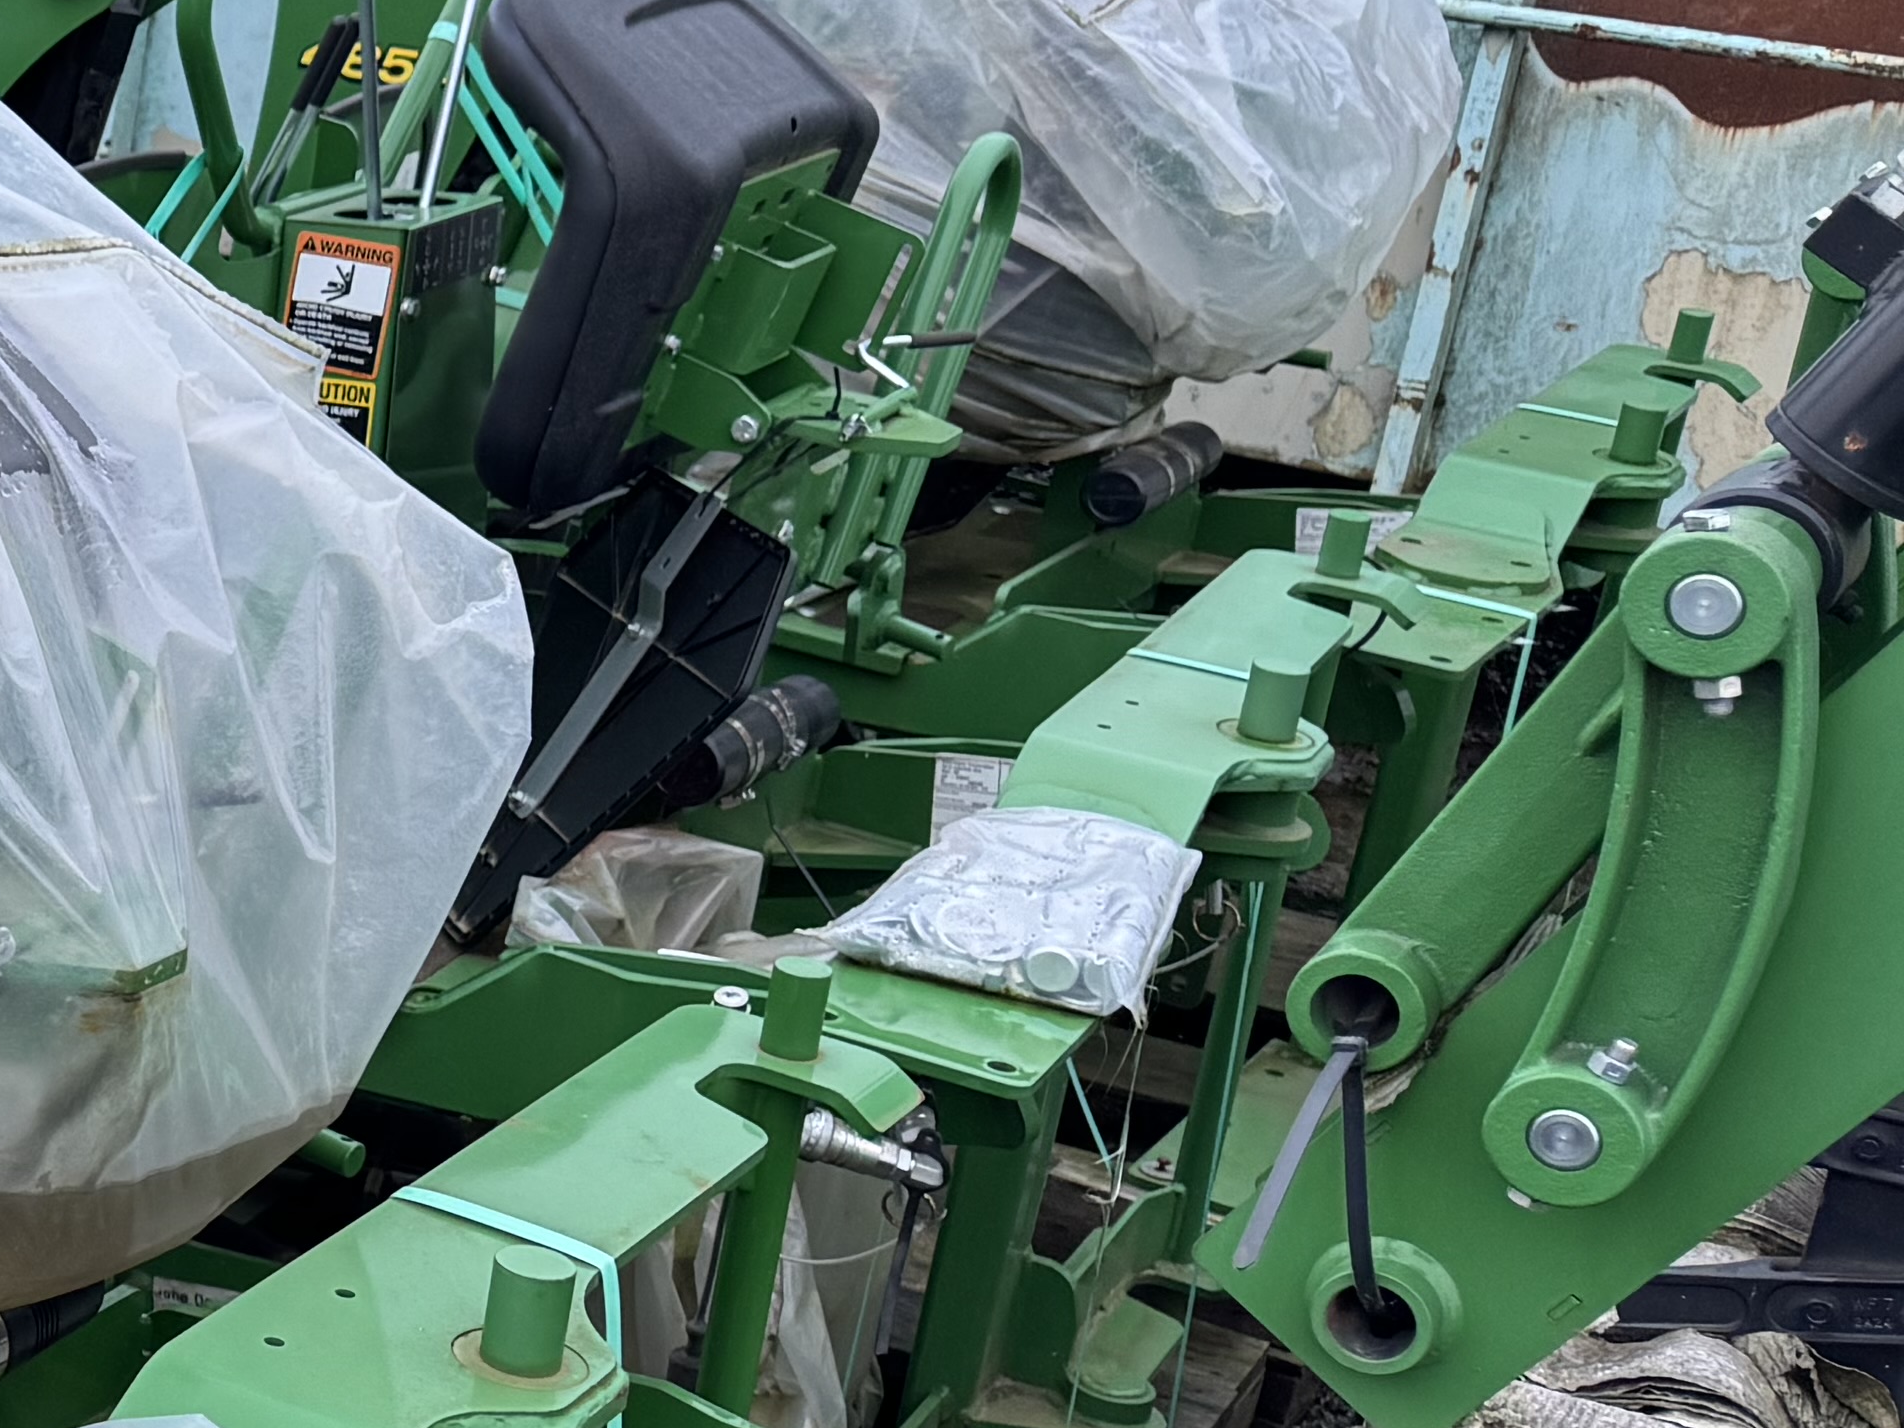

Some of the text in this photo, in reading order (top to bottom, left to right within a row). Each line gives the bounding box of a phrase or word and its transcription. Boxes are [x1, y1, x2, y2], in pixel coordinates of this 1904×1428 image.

[299, 41, 419, 85] 85
[320, 238, 394, 264] WARNING
[319, 382, 371, 404] UTION
